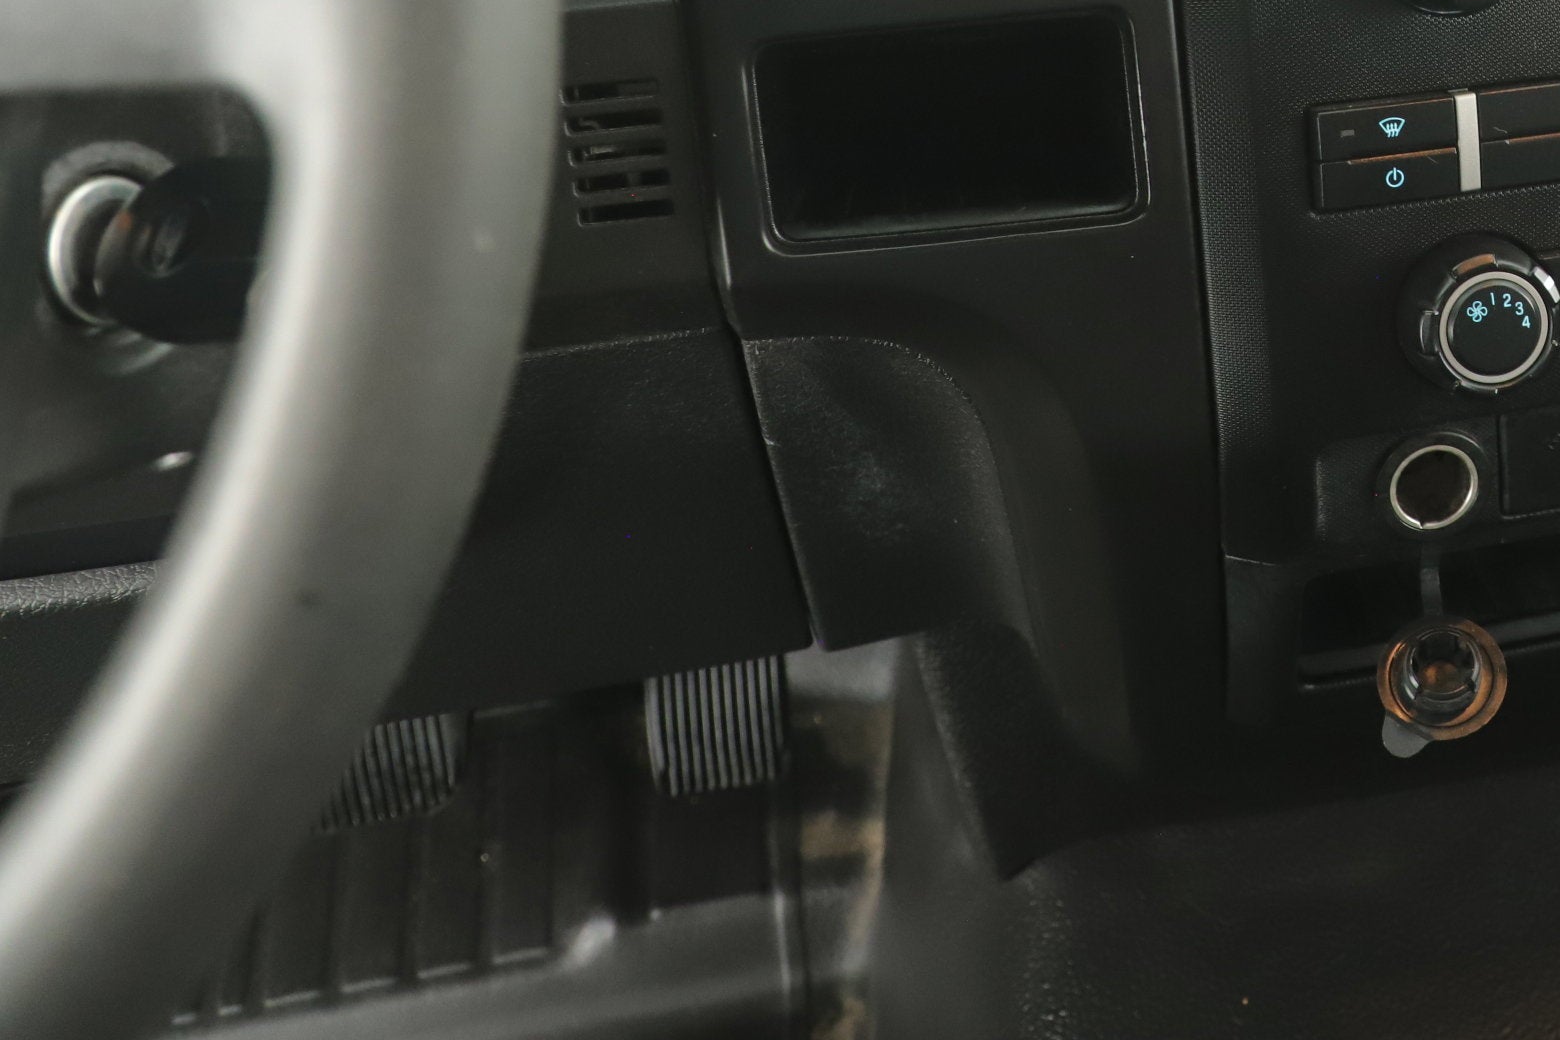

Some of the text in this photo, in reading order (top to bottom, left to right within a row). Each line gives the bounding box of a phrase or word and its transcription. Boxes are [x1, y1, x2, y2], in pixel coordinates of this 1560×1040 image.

[1489, 291, 1532, 329] 1 2 3 4
